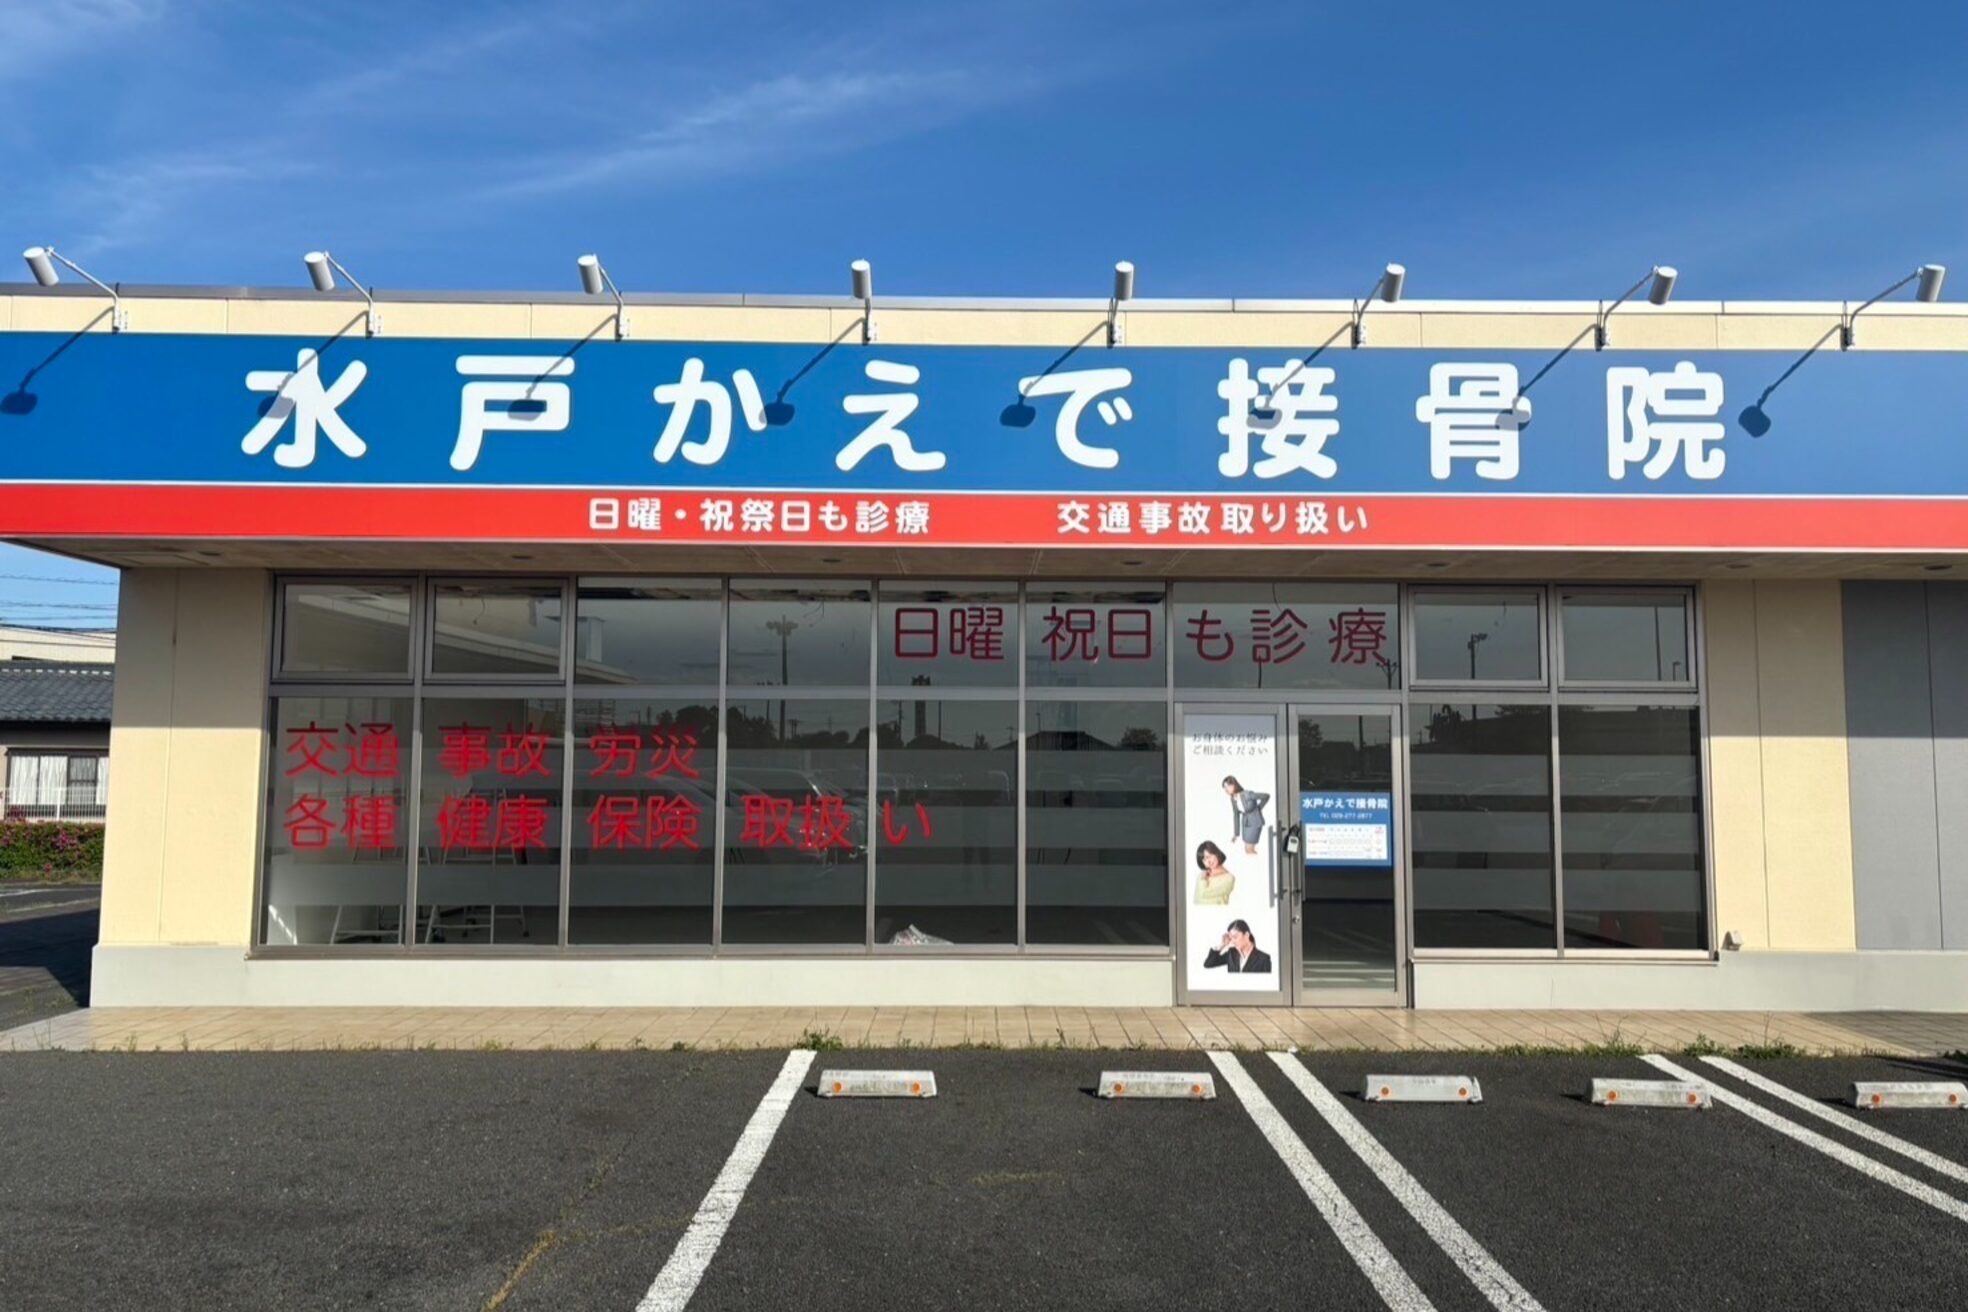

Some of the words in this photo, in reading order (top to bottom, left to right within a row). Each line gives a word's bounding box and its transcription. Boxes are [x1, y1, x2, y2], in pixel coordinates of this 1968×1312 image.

[241, 347, 1726, 481] 水戸かえで接骨院
[589, 497, 930, 535] 日曜・祝祭日も診療
[1057, 501, 1368, 535] 交通事故取り扱い
[1192, 744, 1269, 756] ご相談ください
[1302, 797, 1389, 810] 水戸かえで接骨院
